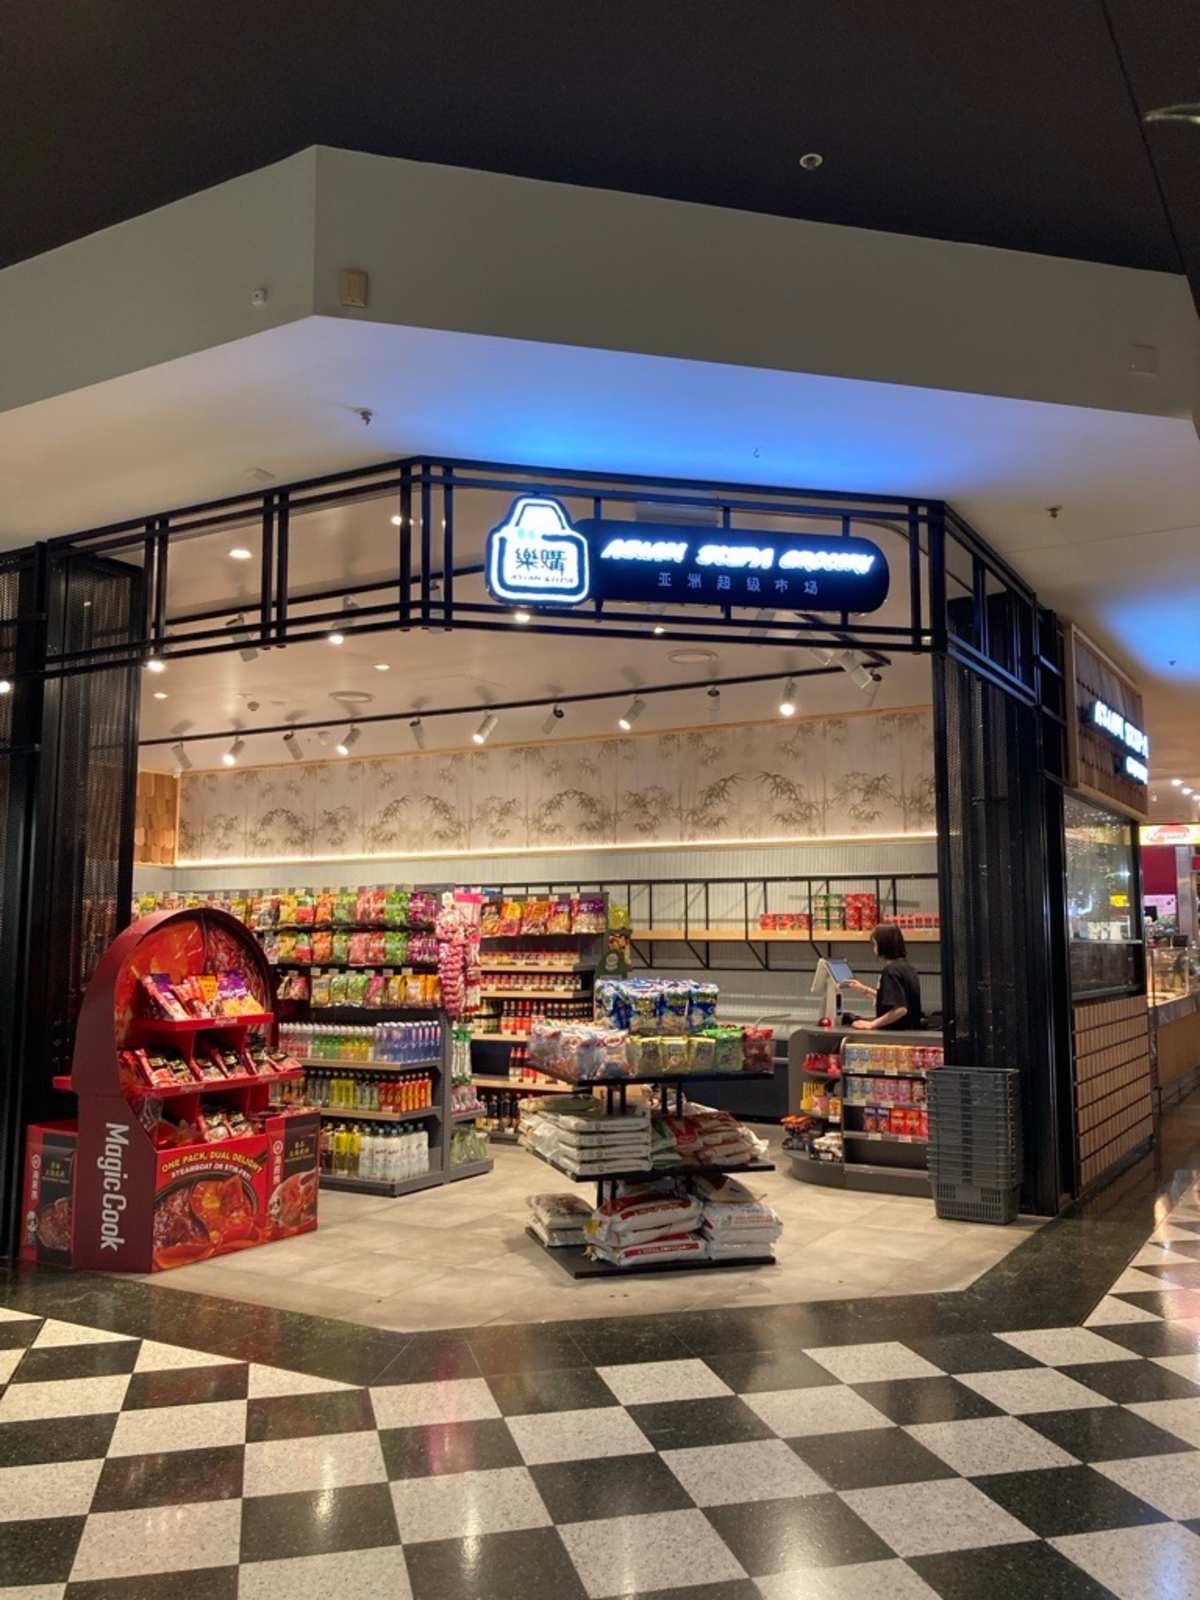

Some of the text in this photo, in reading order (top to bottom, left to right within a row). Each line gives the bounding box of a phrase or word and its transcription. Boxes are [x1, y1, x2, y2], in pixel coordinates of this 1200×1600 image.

[657, 572, 819, 596] 亚洲超级市场
[161, 1159, 180, 1172] ONE
[210, 1151, 230, 1161] DUAL
[232, 1153, 263, 1174] DELIGHT
[97, 1122, 129, 1251] MagicCook
